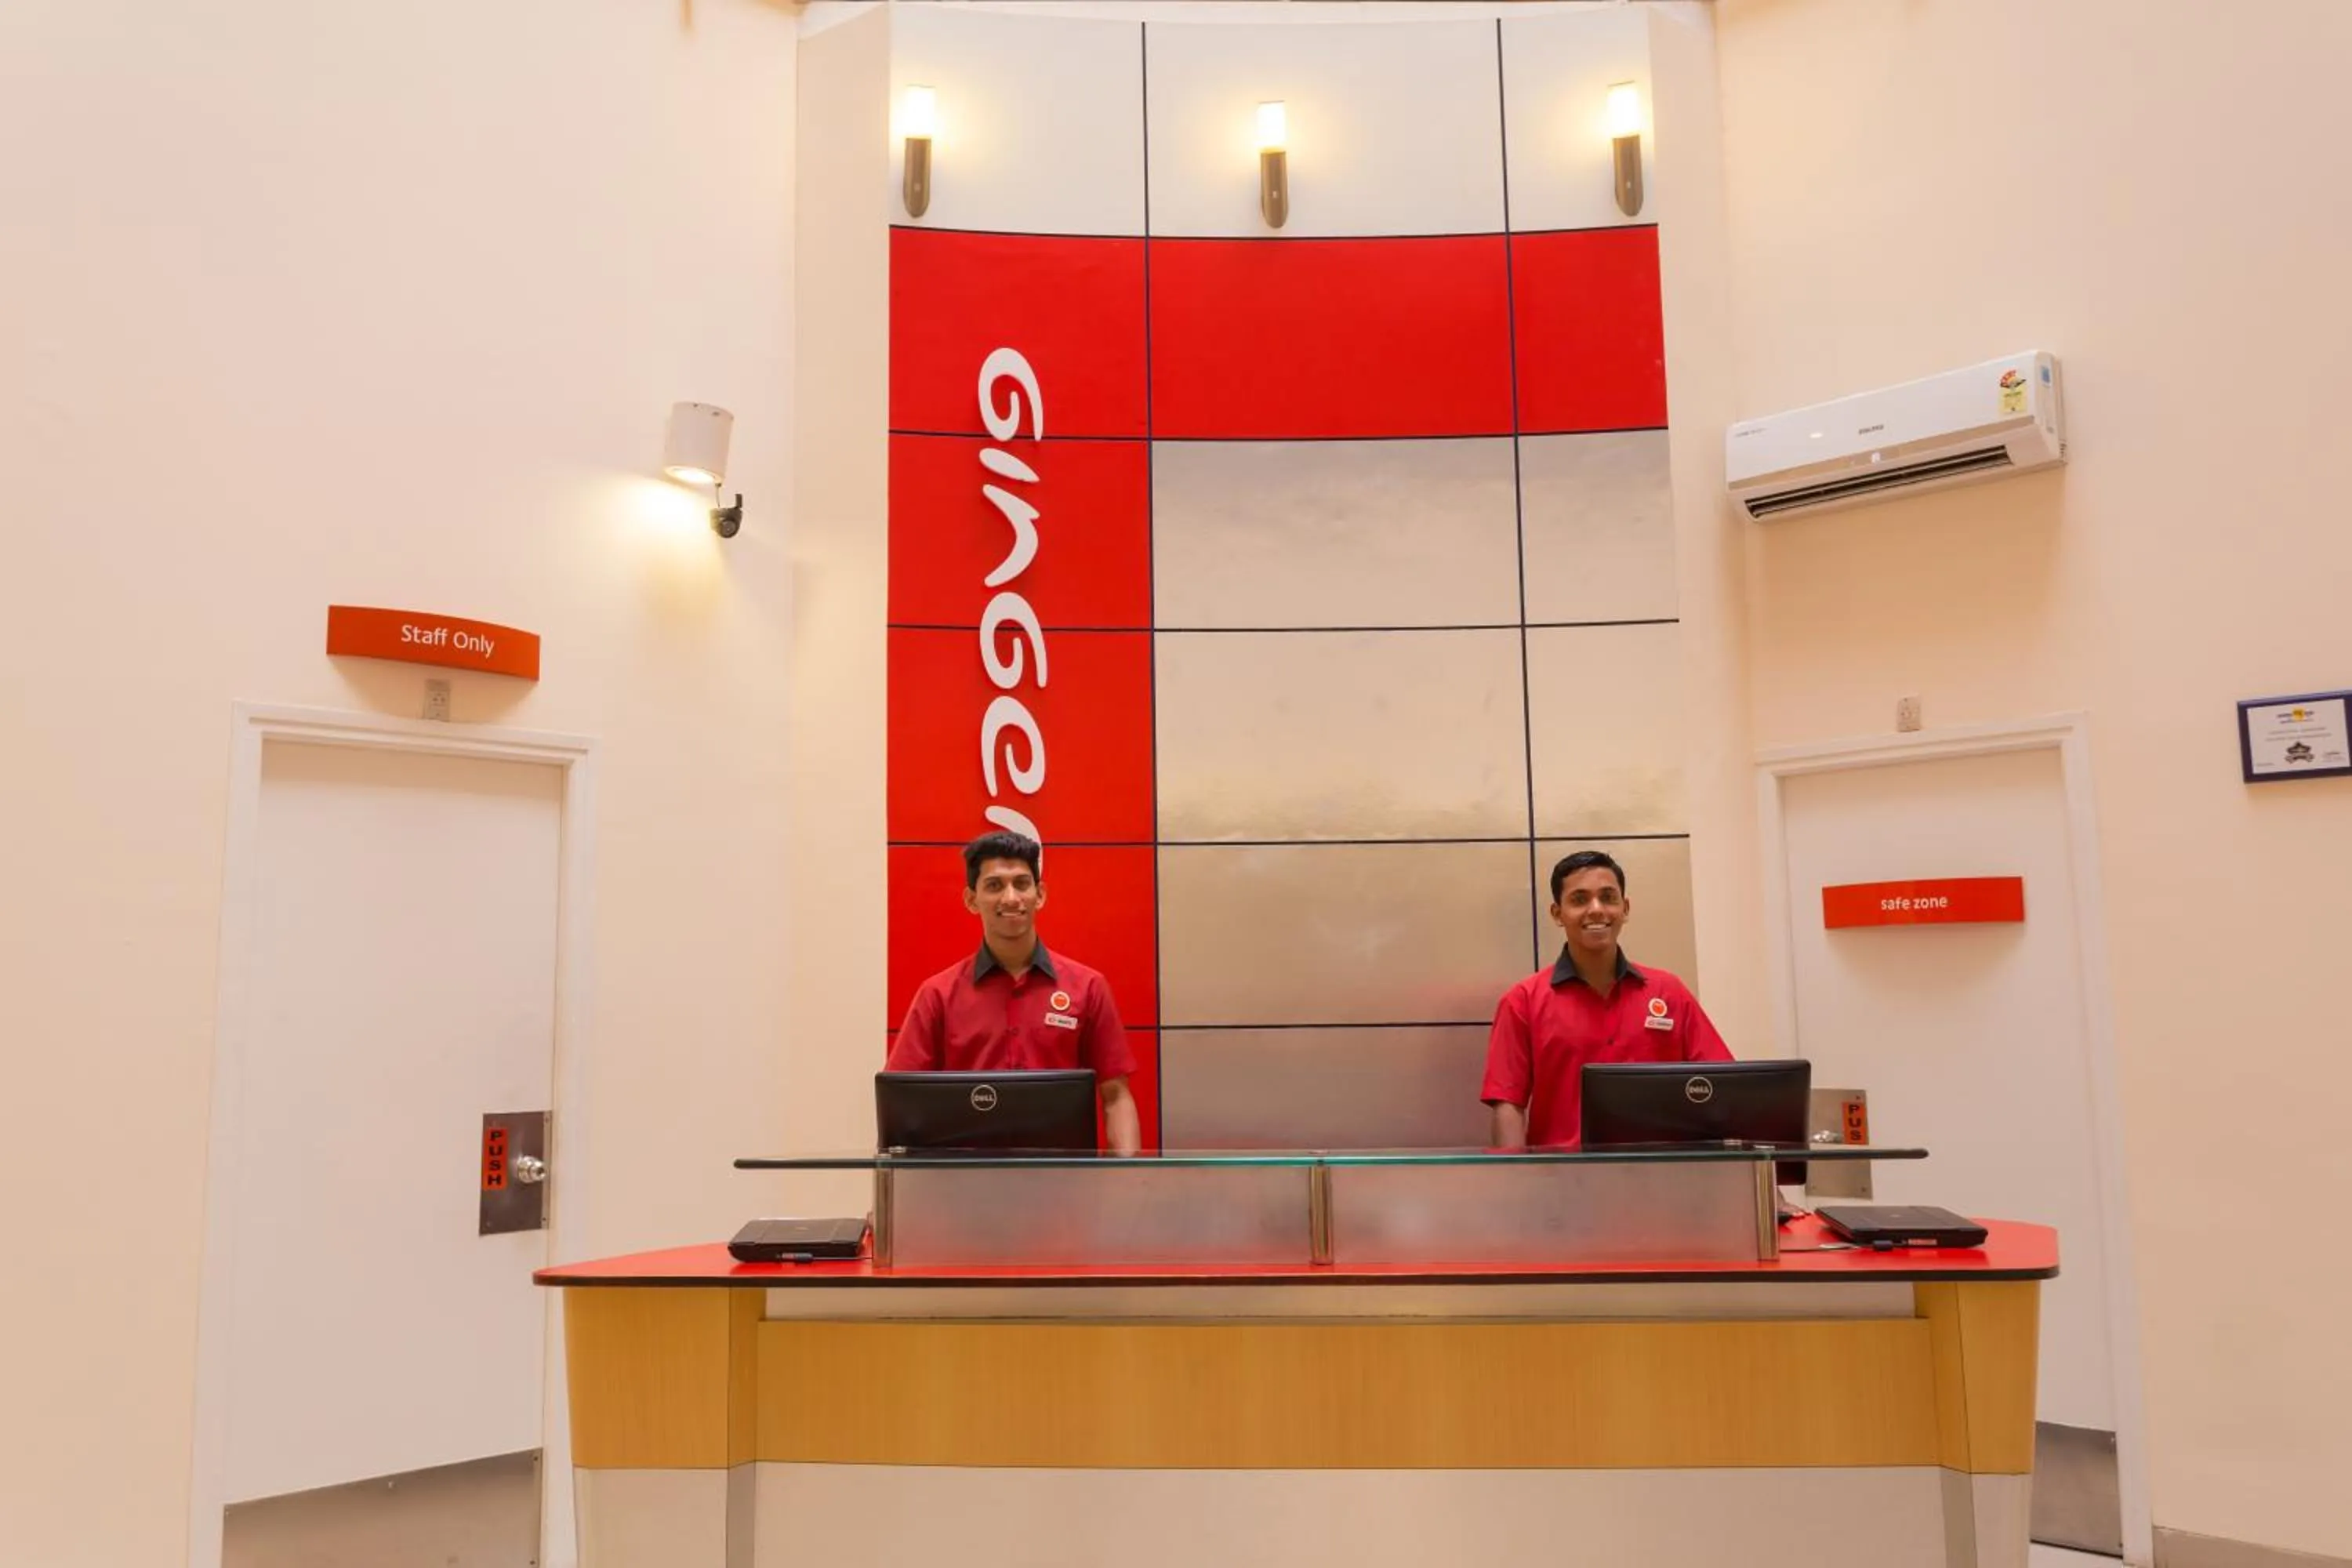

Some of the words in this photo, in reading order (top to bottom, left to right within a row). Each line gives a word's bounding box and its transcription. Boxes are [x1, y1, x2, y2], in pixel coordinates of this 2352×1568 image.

[401, 624, 448, 647] Staff
[453, 631, 494, 659] Only
[1881, 896, 1910, 910] safe
[1913, 896, 1948, 909] zone
[1848, 1104, 1862, 1142] PUS
[487, 1130, 503, 1186] PUSH
